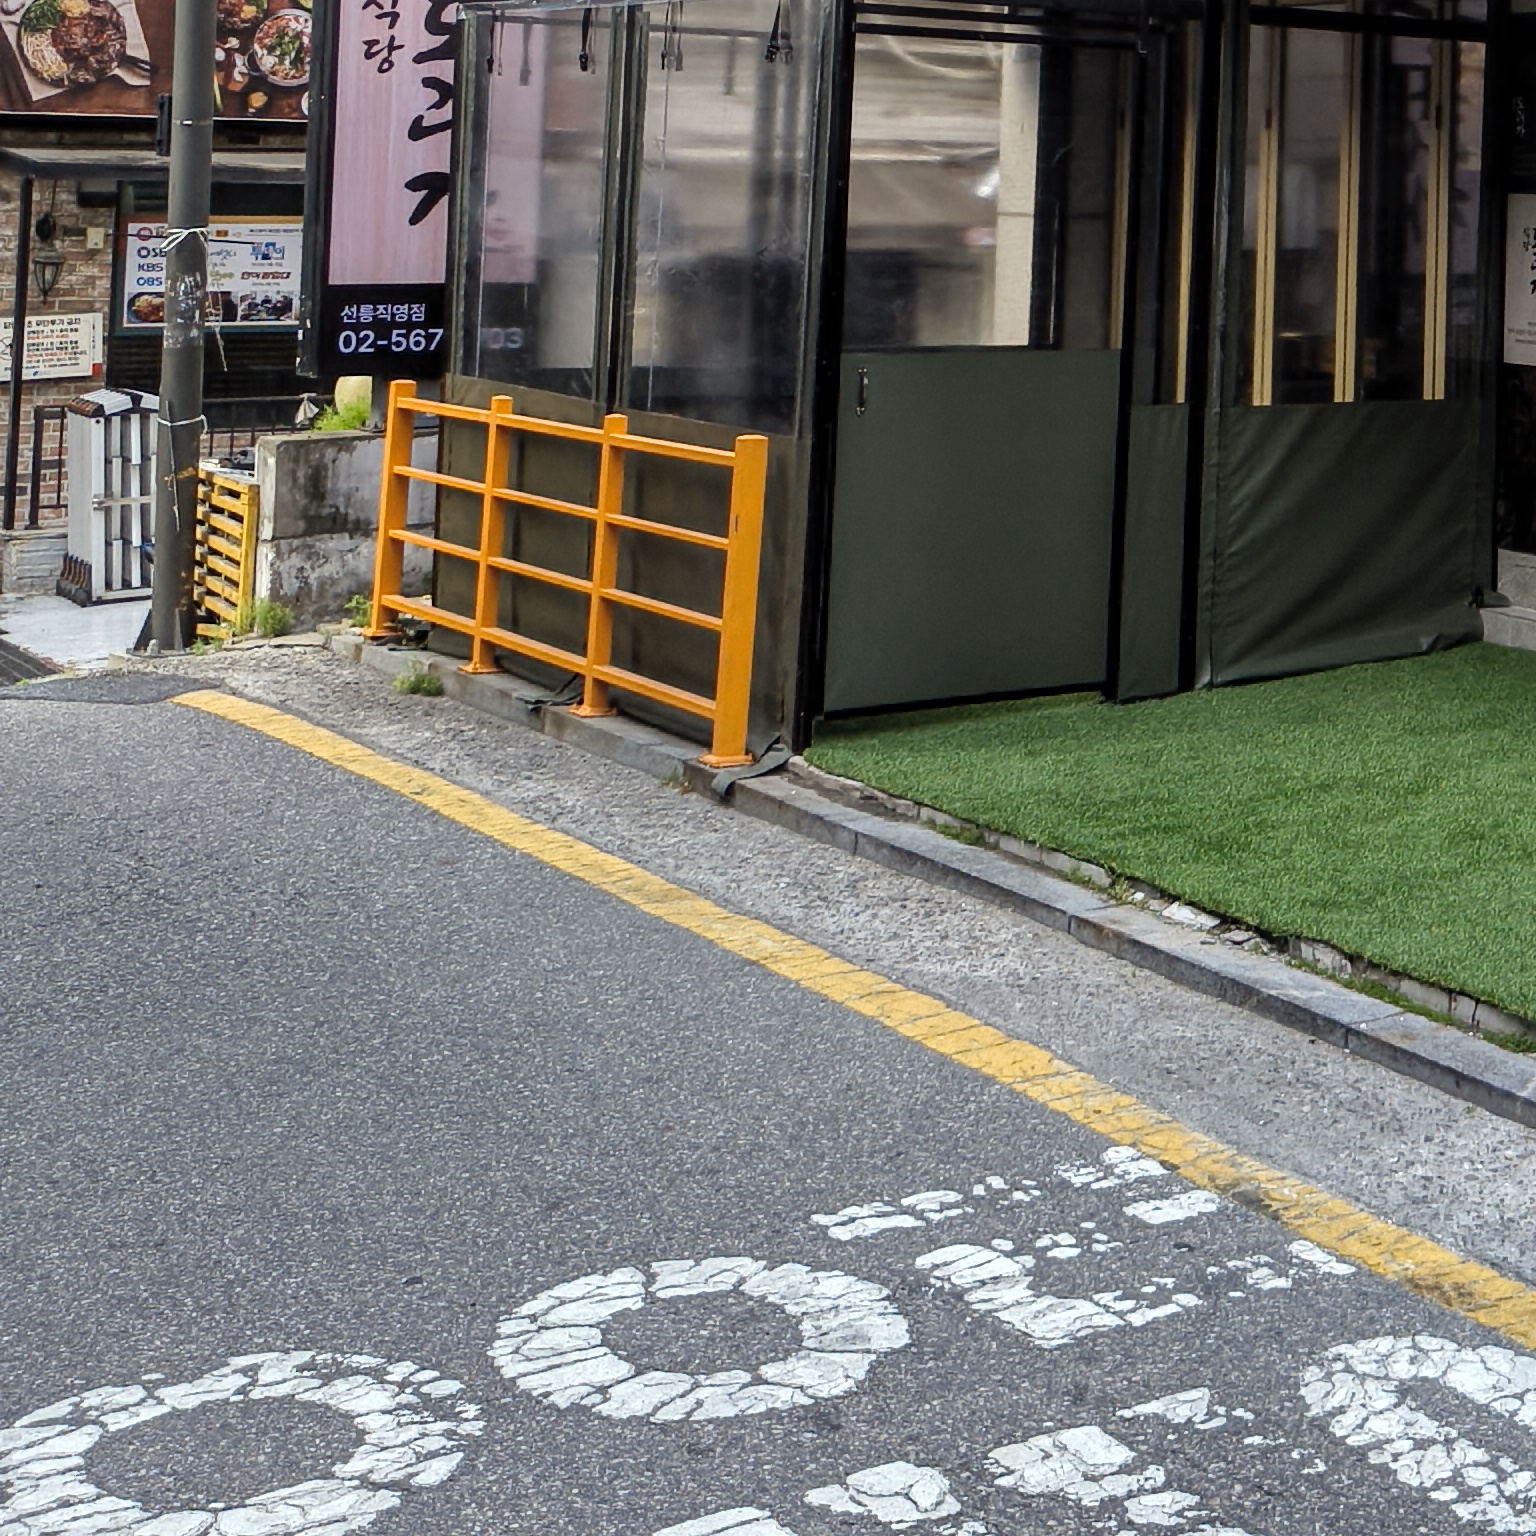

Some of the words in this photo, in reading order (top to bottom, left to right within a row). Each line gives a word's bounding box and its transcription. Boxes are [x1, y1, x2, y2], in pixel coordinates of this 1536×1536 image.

[138, 262, 164, 272] KBS
[136, 276, 163, 286] OBS
[340, 303, 426, 323] 선릉직영점
